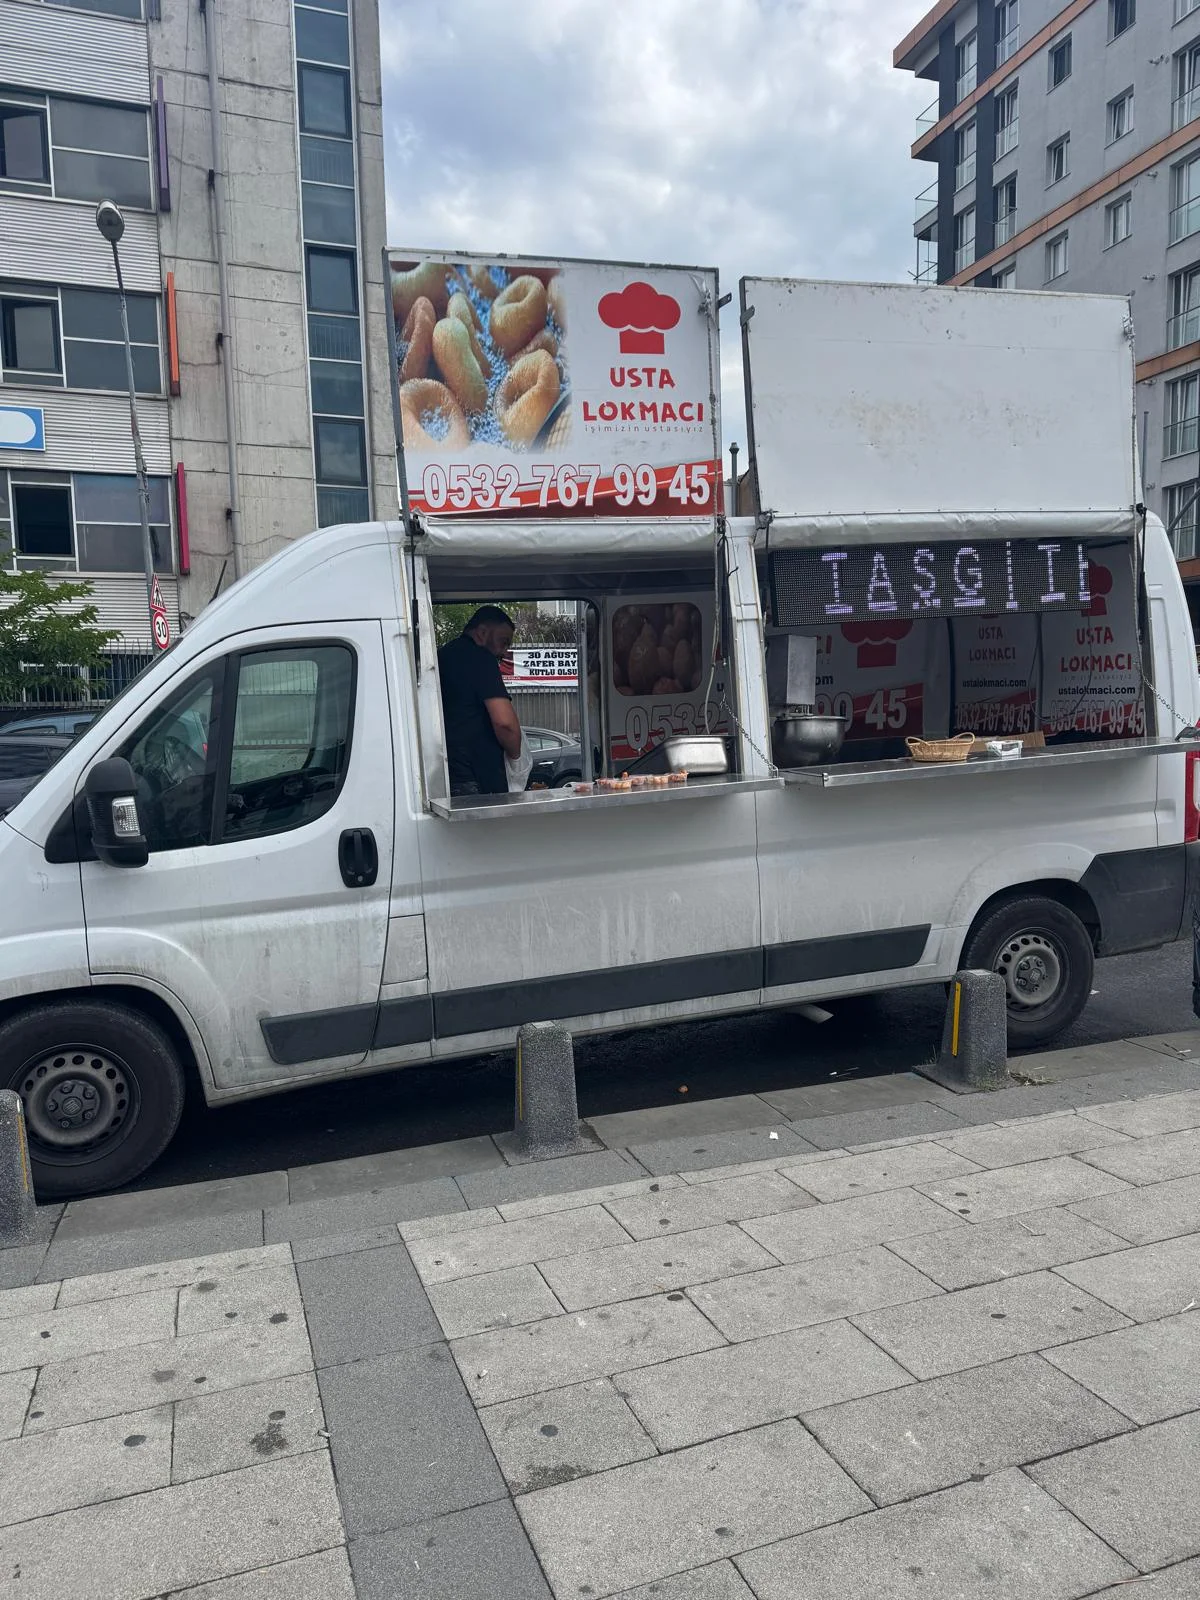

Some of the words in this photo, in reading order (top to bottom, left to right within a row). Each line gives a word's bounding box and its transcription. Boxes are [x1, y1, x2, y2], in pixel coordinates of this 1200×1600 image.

[610, 367, 676, 389] USTA
[582, 401, 704, 423] LOKMACI
[585, 425, 640, 433] işimizin
[423, 464, 521, 508] 0532
[532, 464, 601, 508] 767
[613, 464, 657, 506] 99
[668, 463, 710, 505] 45
[156, 621, 167, 638] 30
[978, 627, 1003, 640] USTA
[1076, 627, 1114, 645] USTA
[969, 647, 1016, 661] LOKMACI
[1060, 653, 1132, 673] LOKMACI
[962, 678, 1027, 688] ustalokmaci.com
[1058, 685, 1136, 695] ustalokmaci.com
[864, 687, 907, 730] 45
[1081, 700, 1105, 733] 767
[1109, 699, 1125, 734] 99
[1128, 700, 1145, 734] 45
